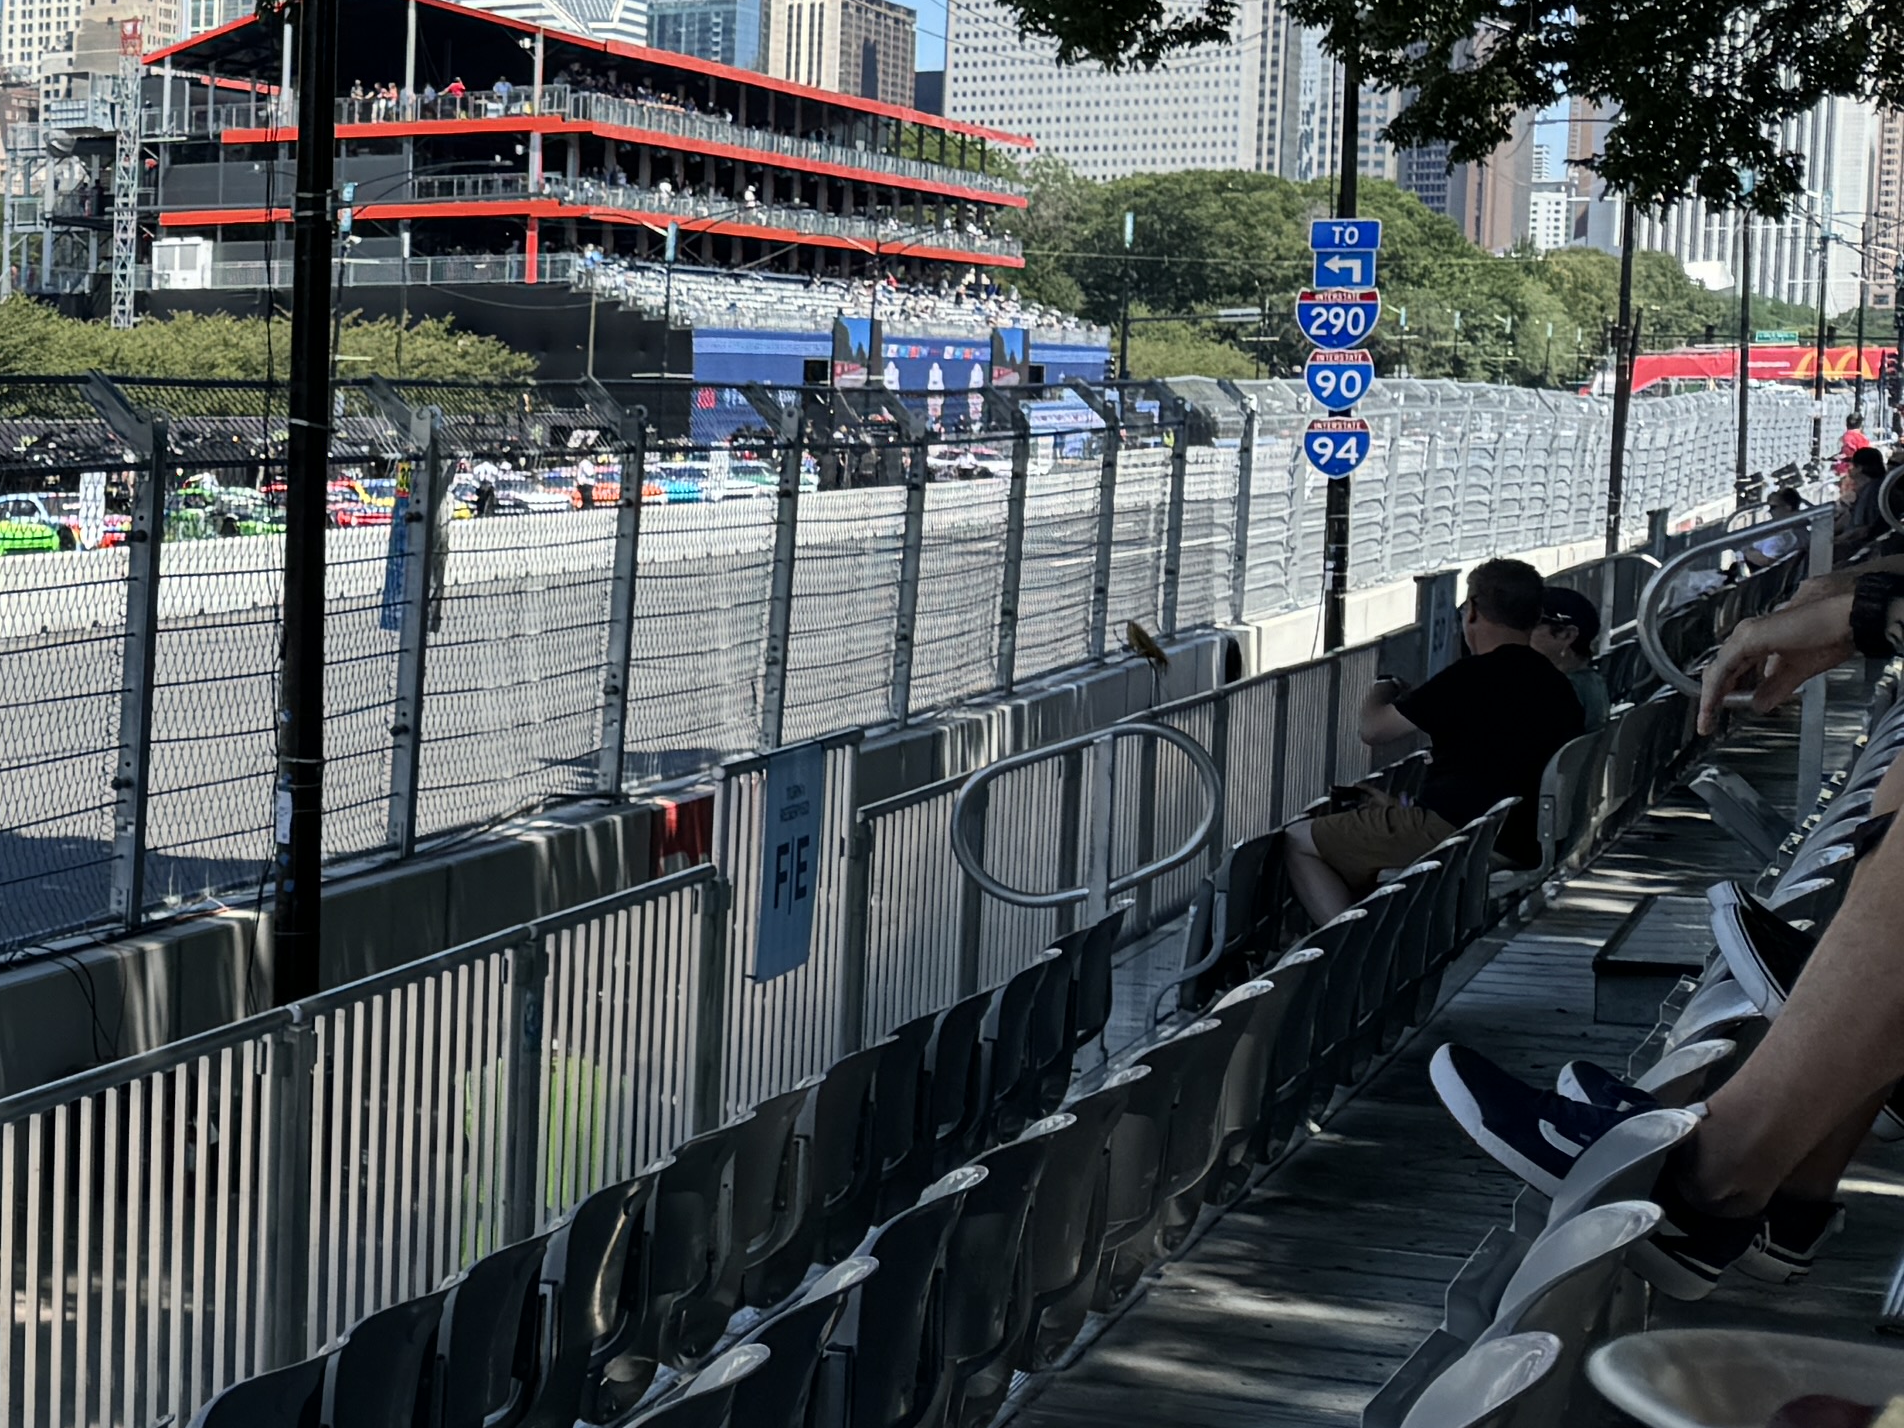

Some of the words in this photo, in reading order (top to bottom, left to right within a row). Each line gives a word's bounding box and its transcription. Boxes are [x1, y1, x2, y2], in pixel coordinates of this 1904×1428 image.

[1332, 226, 1359, 245] TO
[1315, 291, 1361, 302] INTERSTATE
[1309, 306, 1366, 336] 290
[1316, 352, 1363, 363] INTERSTATE
[1315, 370, 1362, 398] 90
[1313, 420, 1363, 430] INTERSTATE
[1312, 437, 1359, 465] 94
